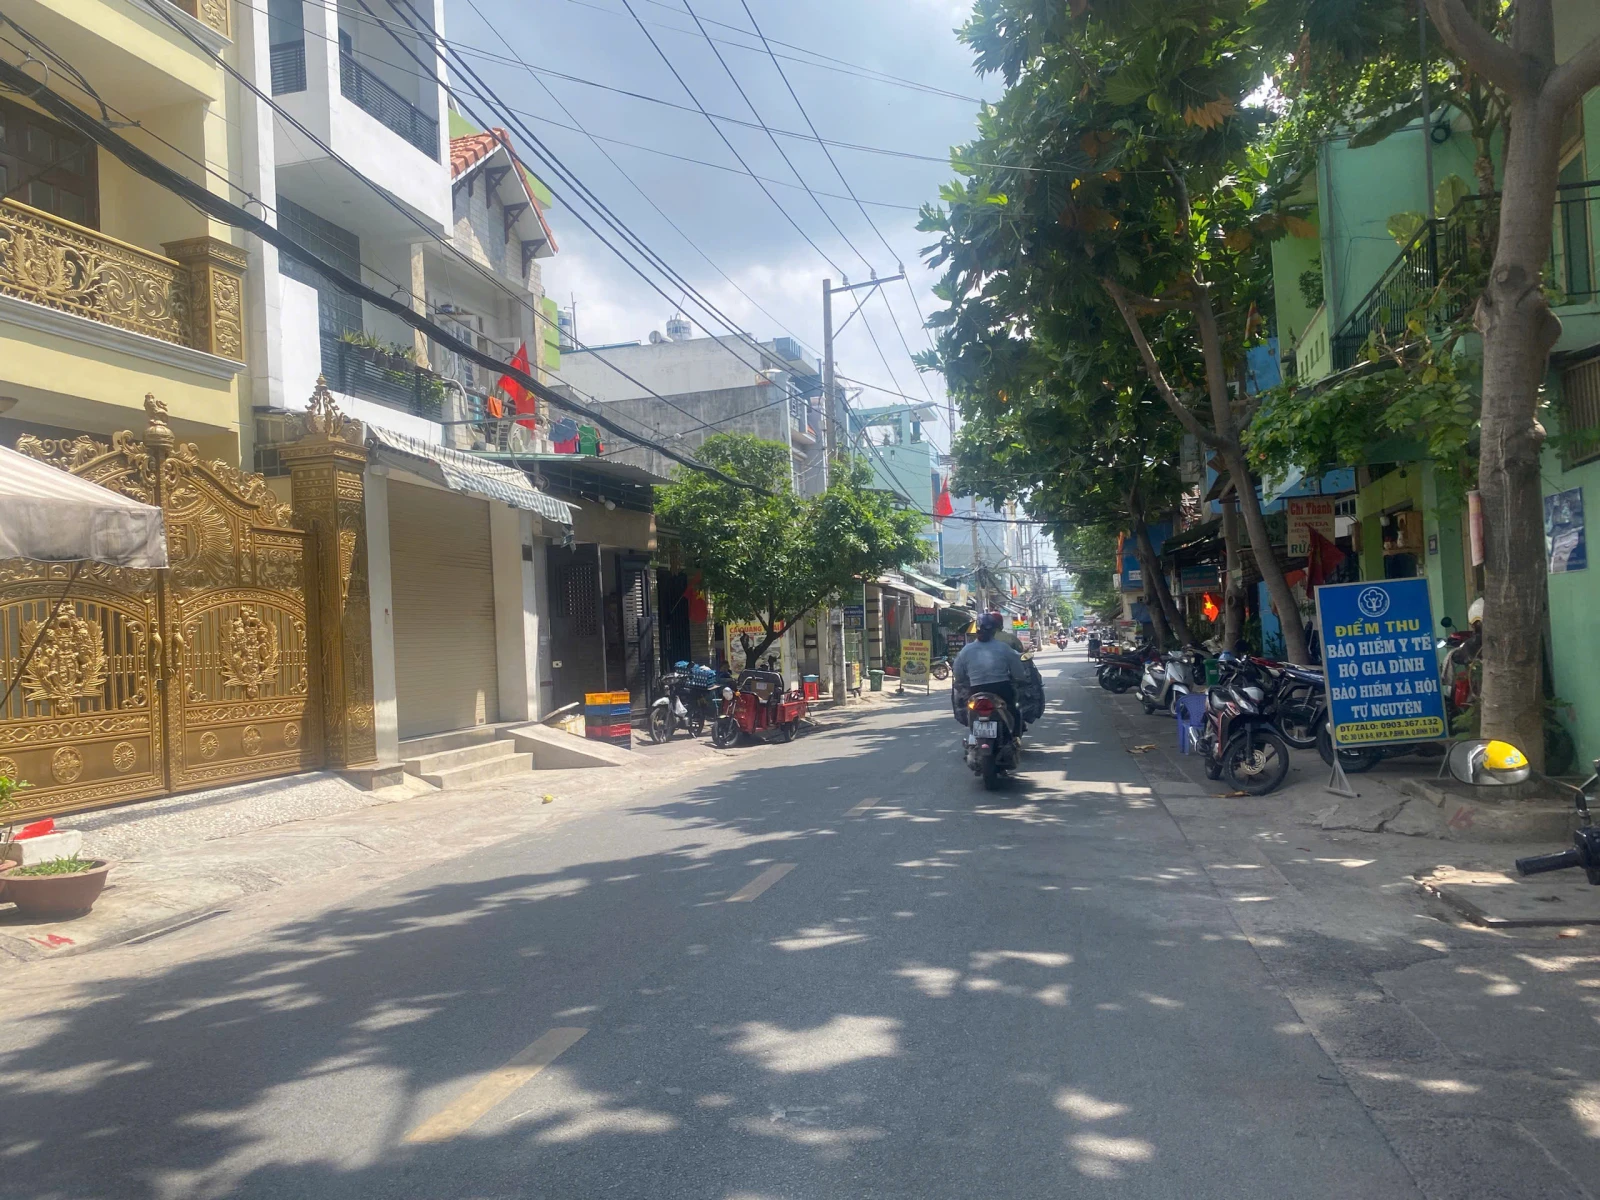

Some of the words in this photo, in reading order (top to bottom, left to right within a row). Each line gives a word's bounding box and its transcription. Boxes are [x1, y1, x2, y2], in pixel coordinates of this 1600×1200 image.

[1335, 618, 1380, 637] ĐIỂM
[1385, 619, 1420, 633] THU
[1327, 639, 1355, 658] BẢO
[1358, 636, 1396, 656] HIỂM
[1398, 638, 1408, 652] Y
[1411, 632, 1432, 651] TẾ
[1338, 663, 1359, 680] HỘ
[1361, 660, 1386, 676] GIA
[1389, 656, 1425, 674] ĐÌNH
[1332, 682, 1357, 701] BẢO
[1359, 680, 1393, 698] HIỂM
[1395, 678, 1411, 695] XÃ
[1414, 679, 1438, 696] HỘI
[1351, 703, 1368, 721] TỰ
[1372, 698, 1422, 717] NGUYỆN
[1380, 718, 1438, 729] 0903.367.132
